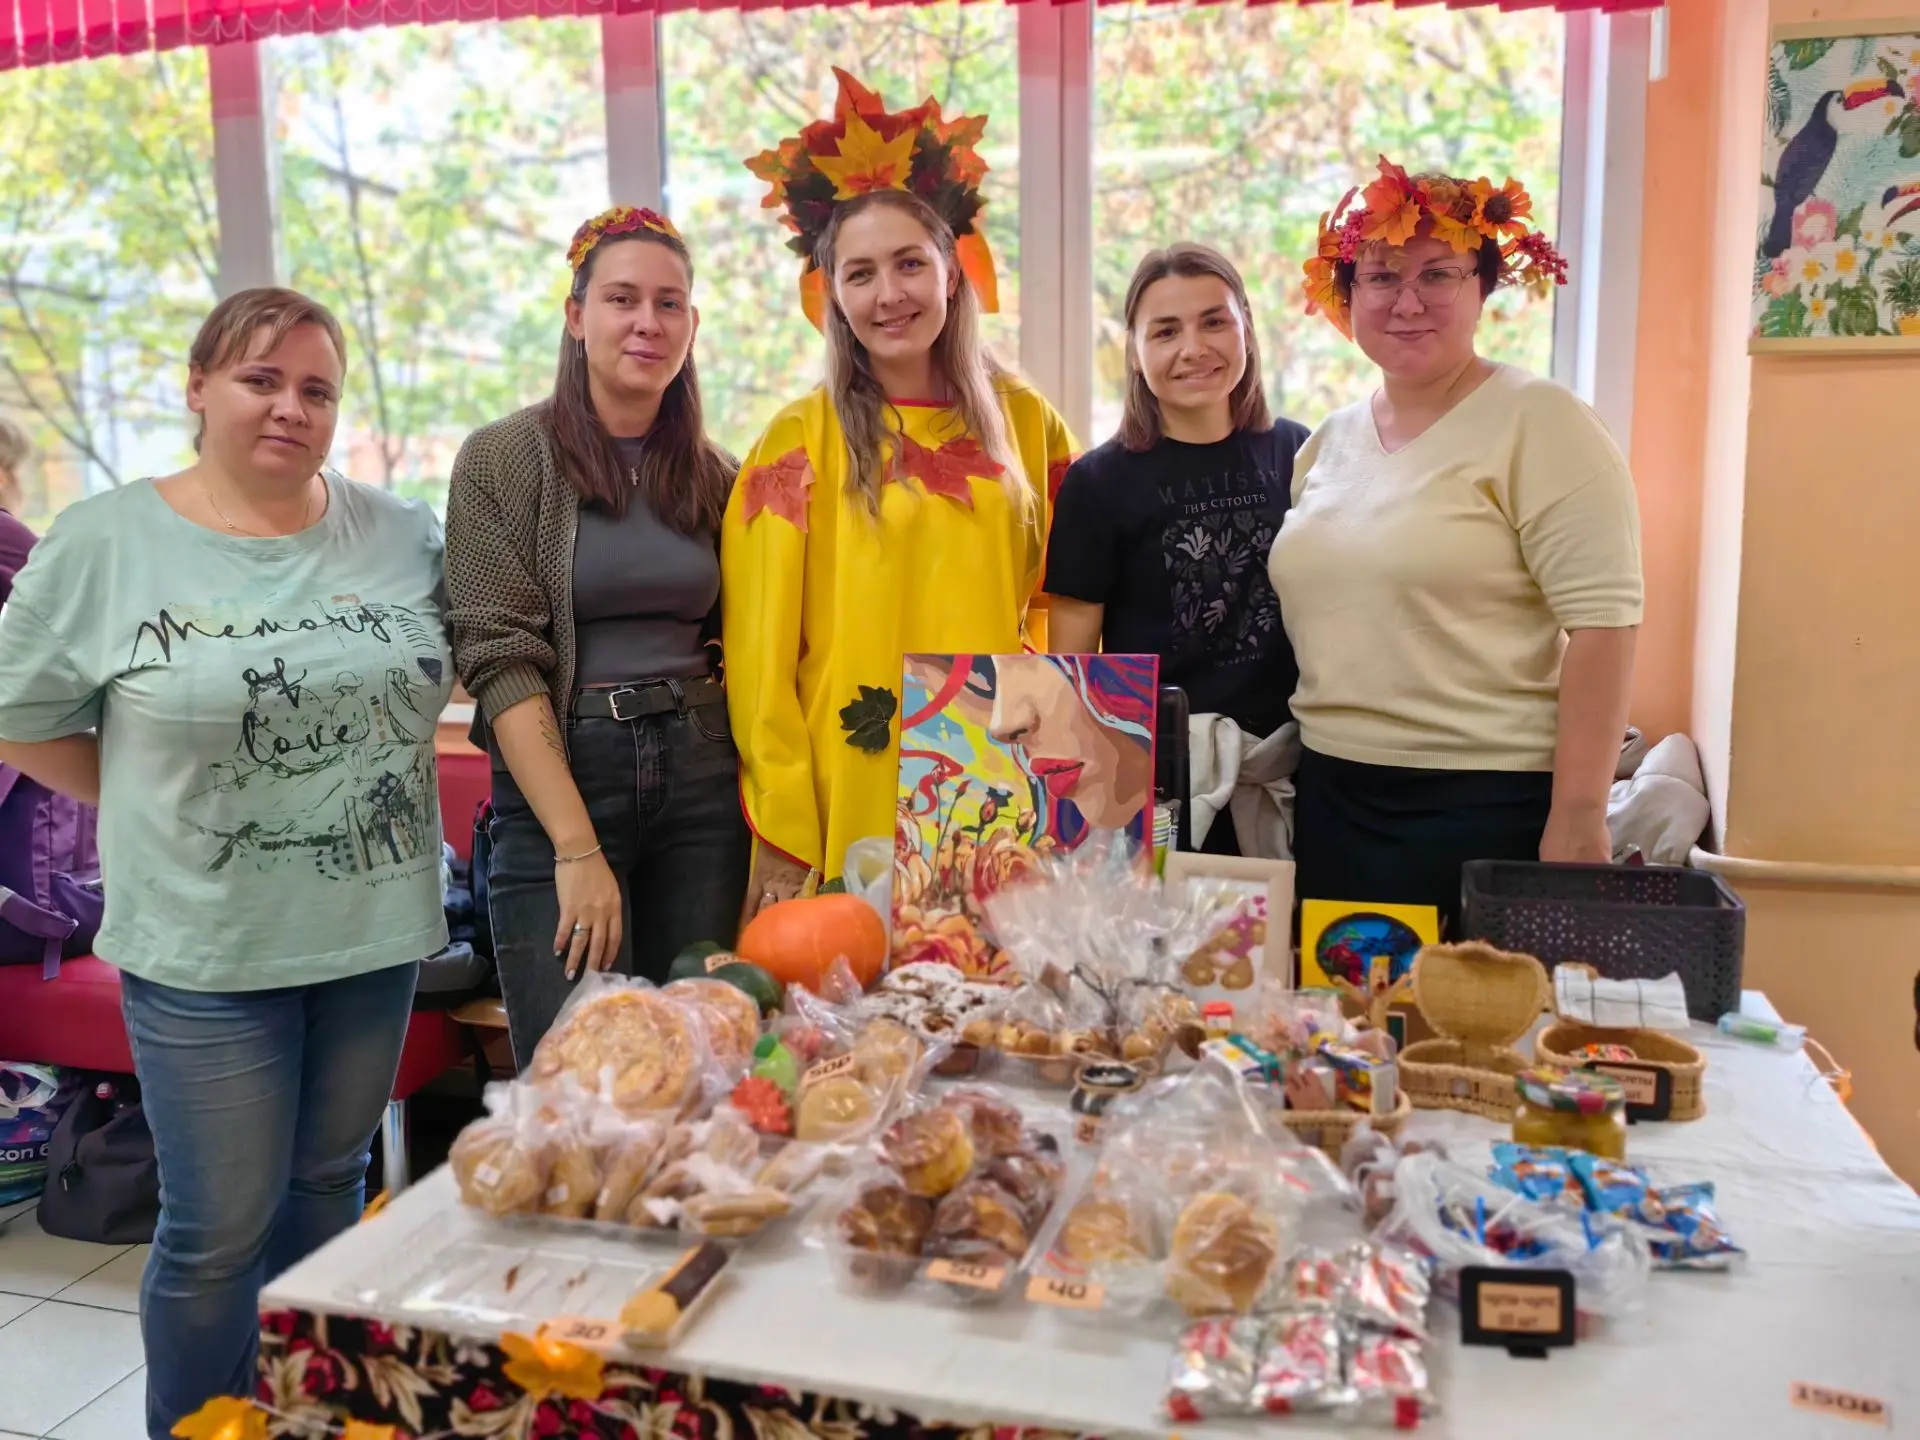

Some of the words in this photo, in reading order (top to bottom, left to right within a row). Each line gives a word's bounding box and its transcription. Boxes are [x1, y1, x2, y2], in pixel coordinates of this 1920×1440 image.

[1182, 501, 1208, 515] THE
[129, 608, 391, 670] Memory
[242, 656, 307, 708] of
[1047, 1280, 1087, 1299] 40
